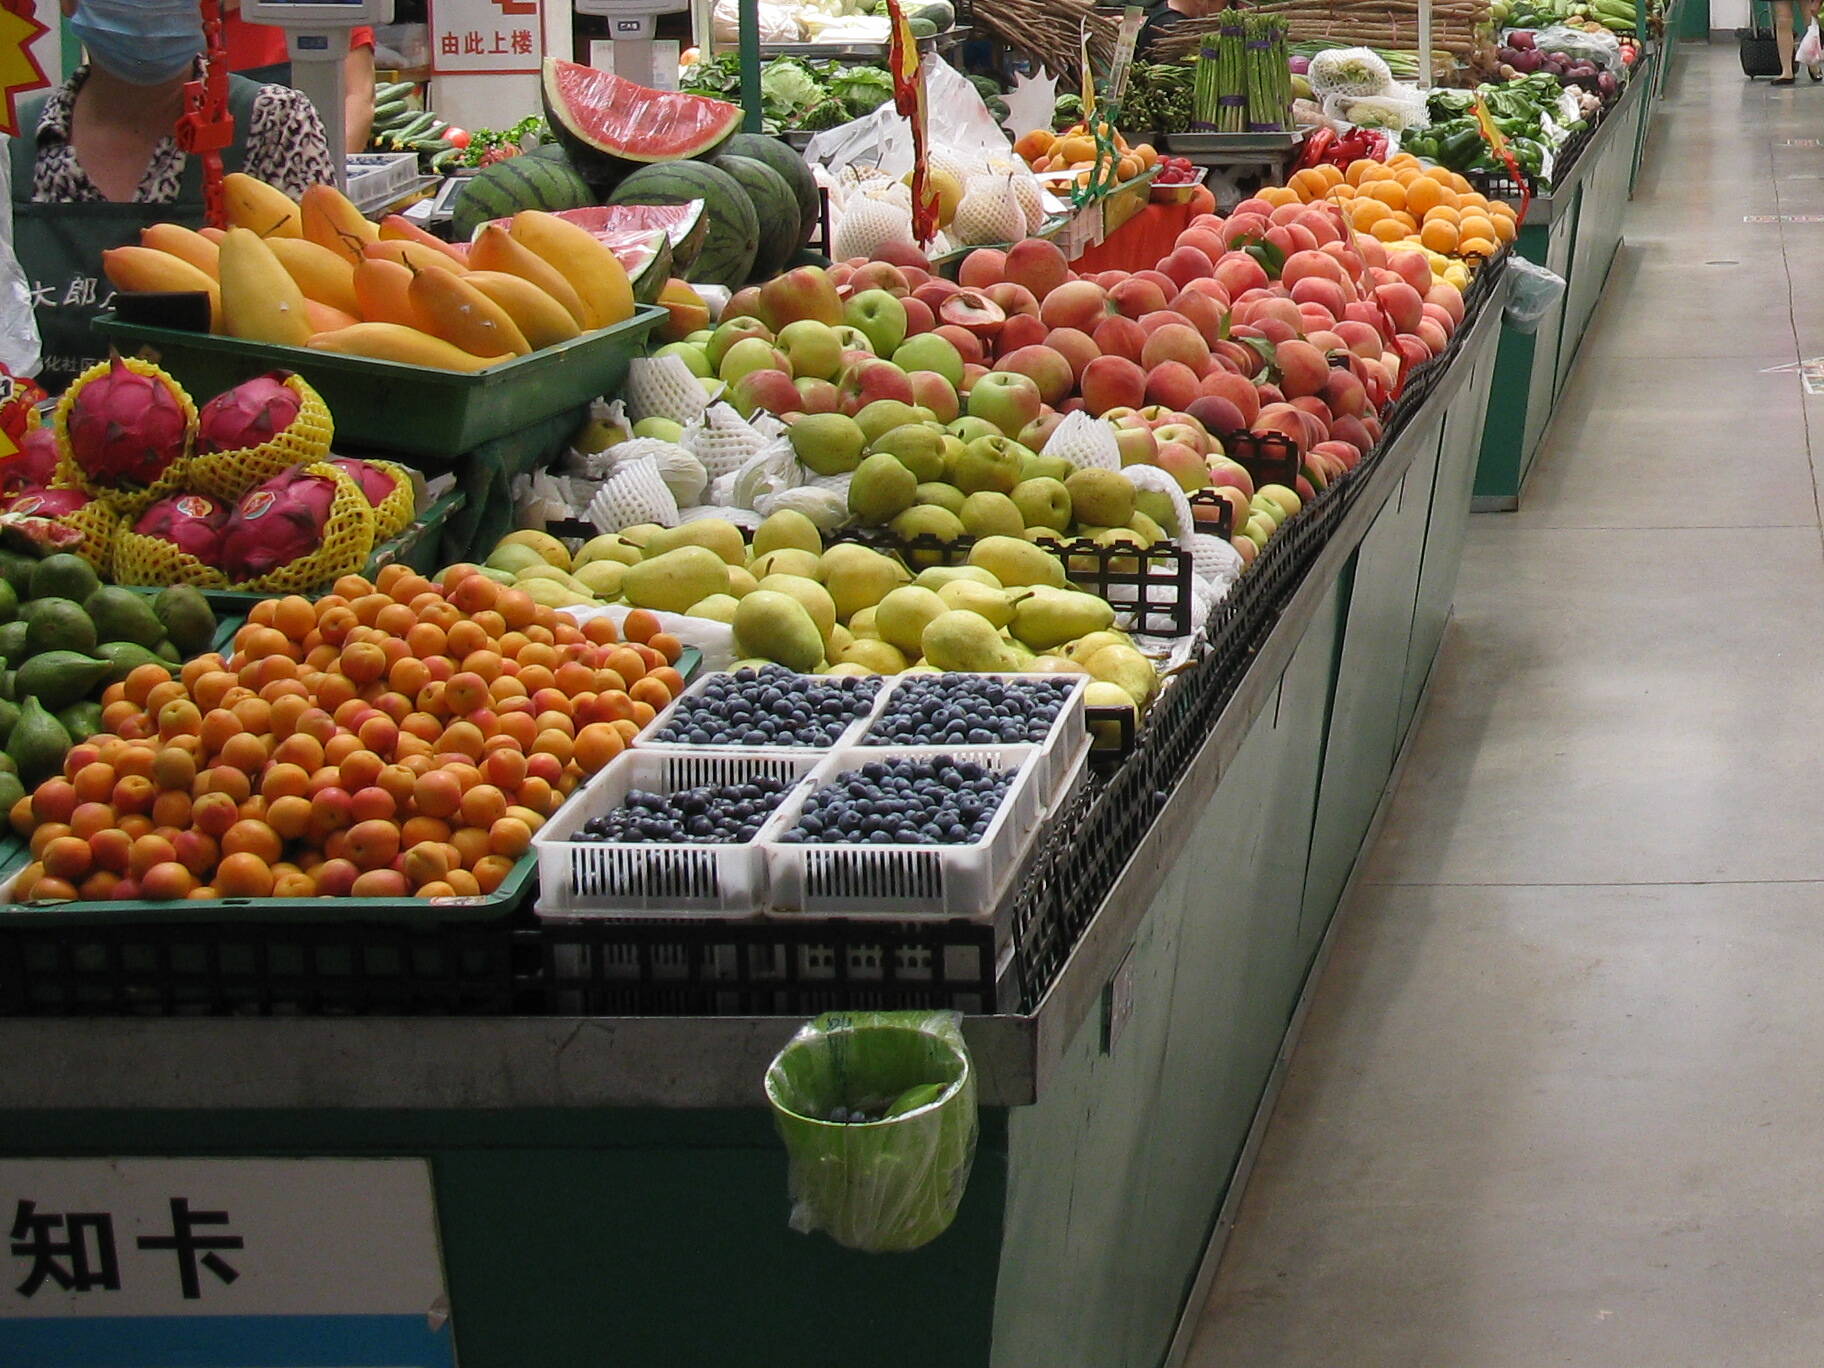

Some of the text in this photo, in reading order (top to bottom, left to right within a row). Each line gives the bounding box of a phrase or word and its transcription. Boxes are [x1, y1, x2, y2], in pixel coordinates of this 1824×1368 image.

[441, 29, 533, 57] 由此上楼
[10, 1196, 245, 1301] 知卡
